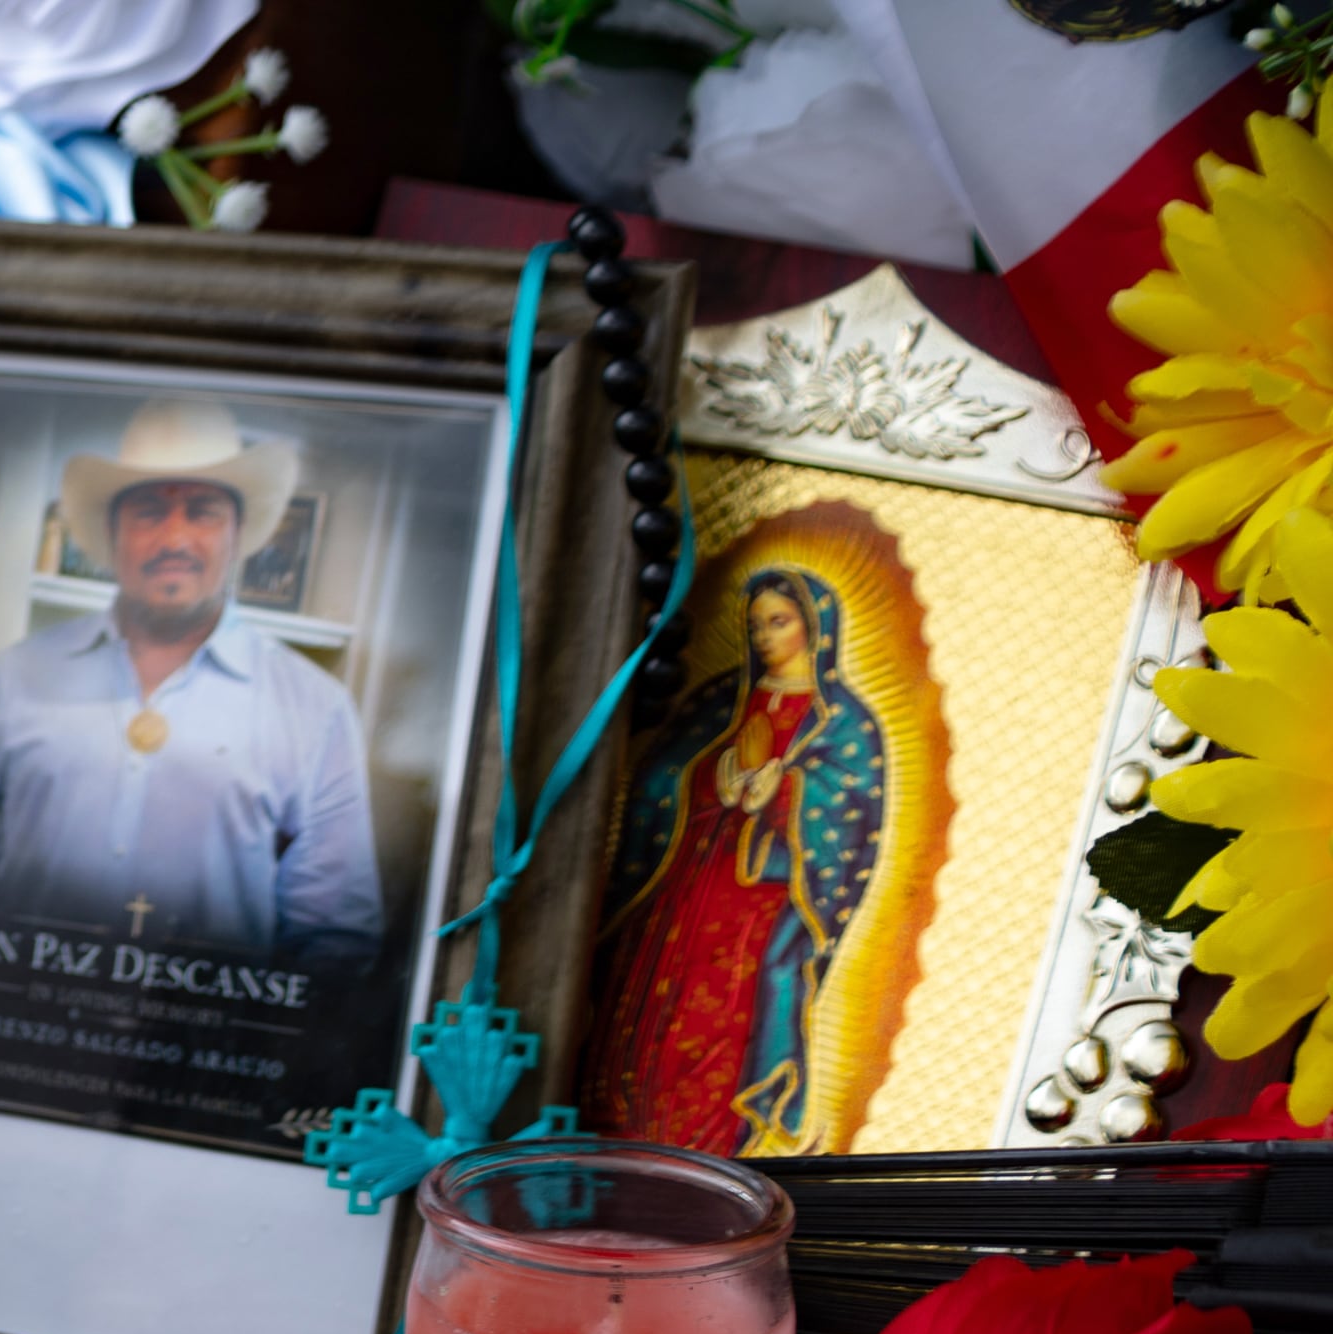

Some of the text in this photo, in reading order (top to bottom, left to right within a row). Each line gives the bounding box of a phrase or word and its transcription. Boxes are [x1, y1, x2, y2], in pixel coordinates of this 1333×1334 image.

[31, 932, 102, 978] PAZ
[110, 944, 311, 1008] DESCANSE
[72, 1029, 183, 1064] SALGADO
